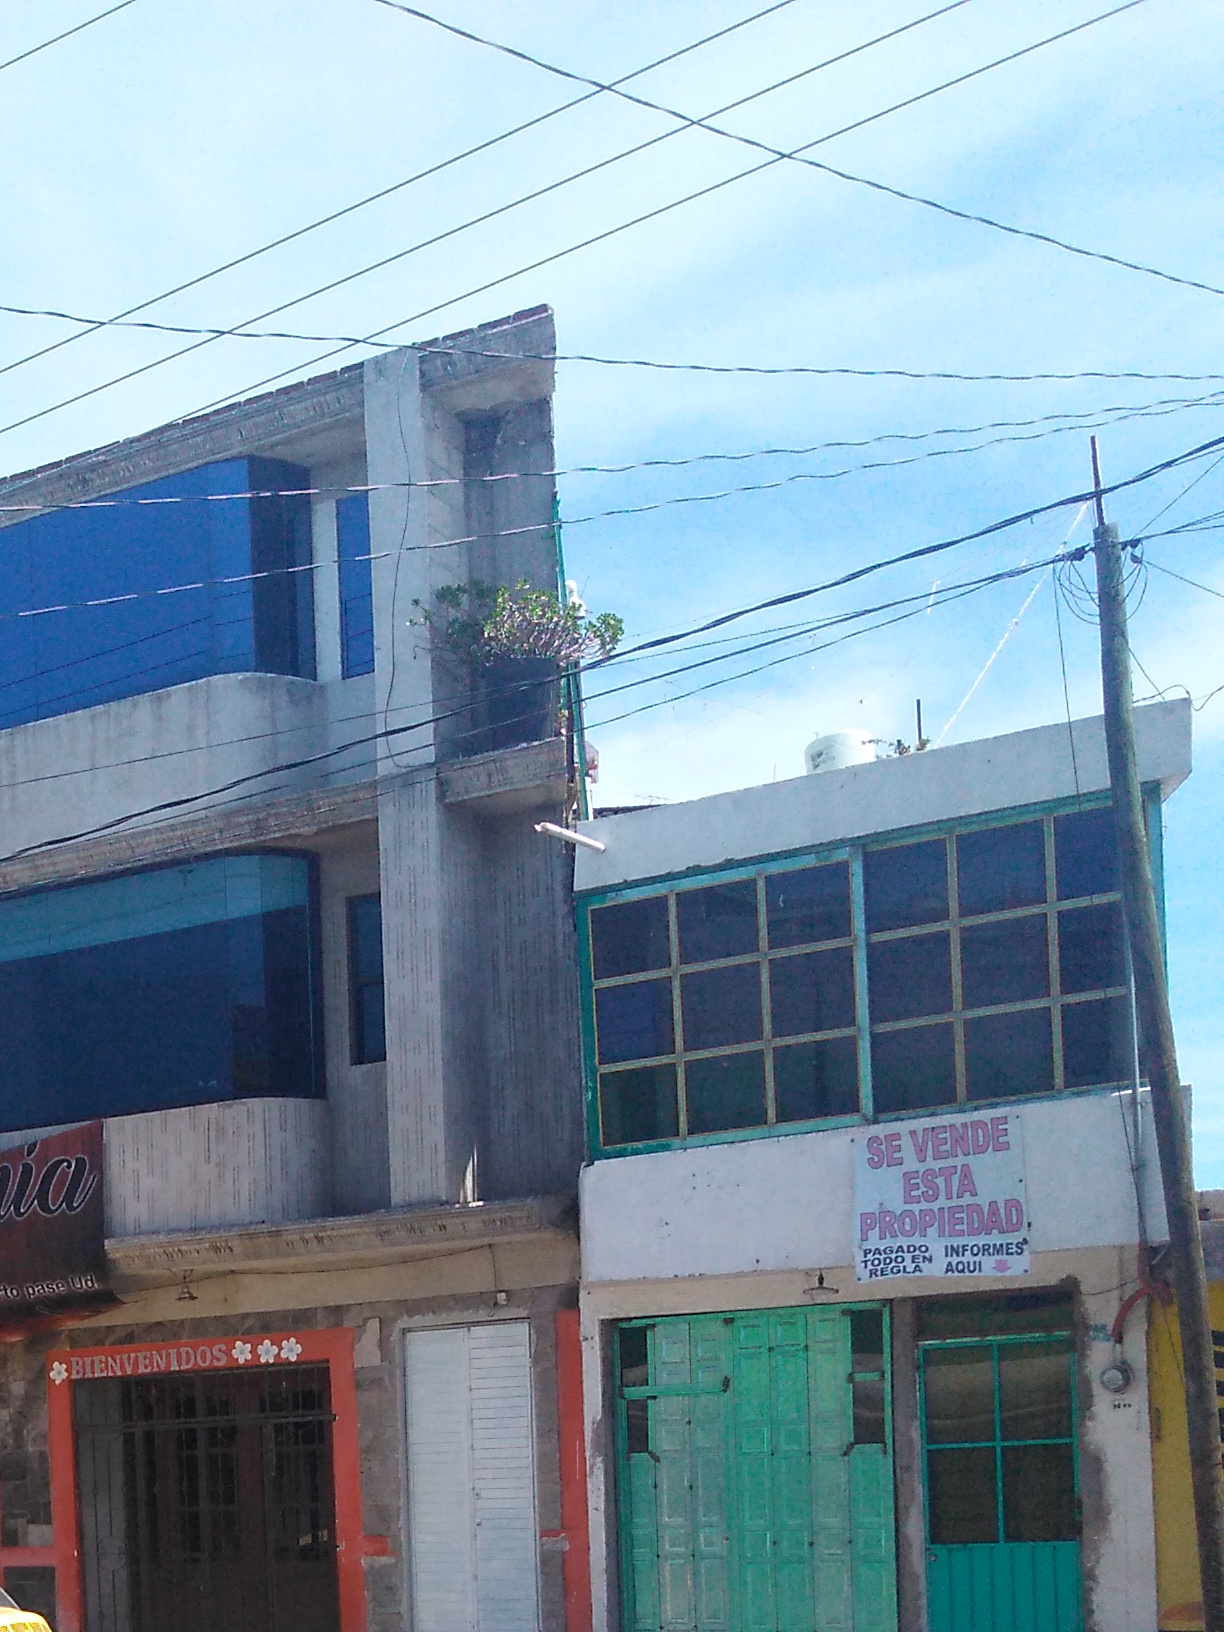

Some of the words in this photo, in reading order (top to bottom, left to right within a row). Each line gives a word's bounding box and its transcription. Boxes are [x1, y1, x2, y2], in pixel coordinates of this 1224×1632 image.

[866, 1132, 904, 1170] SE
[908, 1115, 1011, 1163] VENDE
[902, 1163, 978, 1205] ESTA
[859, 1198, 1025, 1242] PROPIEDAD
[862, 1244, 930, 1259] PAGADO
[944, 1241, 1025, 1258] INFORMES
[861, 1254, 905, 1270] TODO
[911, 1254, 933, 1264] EN
[868, 1264, 924, 1279] REGLA
[944, 1260, 982, 1275] AQUI
[25, 1280, 66, 1300] pase
[70, 1274, 100, 1292] Ud.
[70, 1344, 227, 1379] BIENVENIDOS
